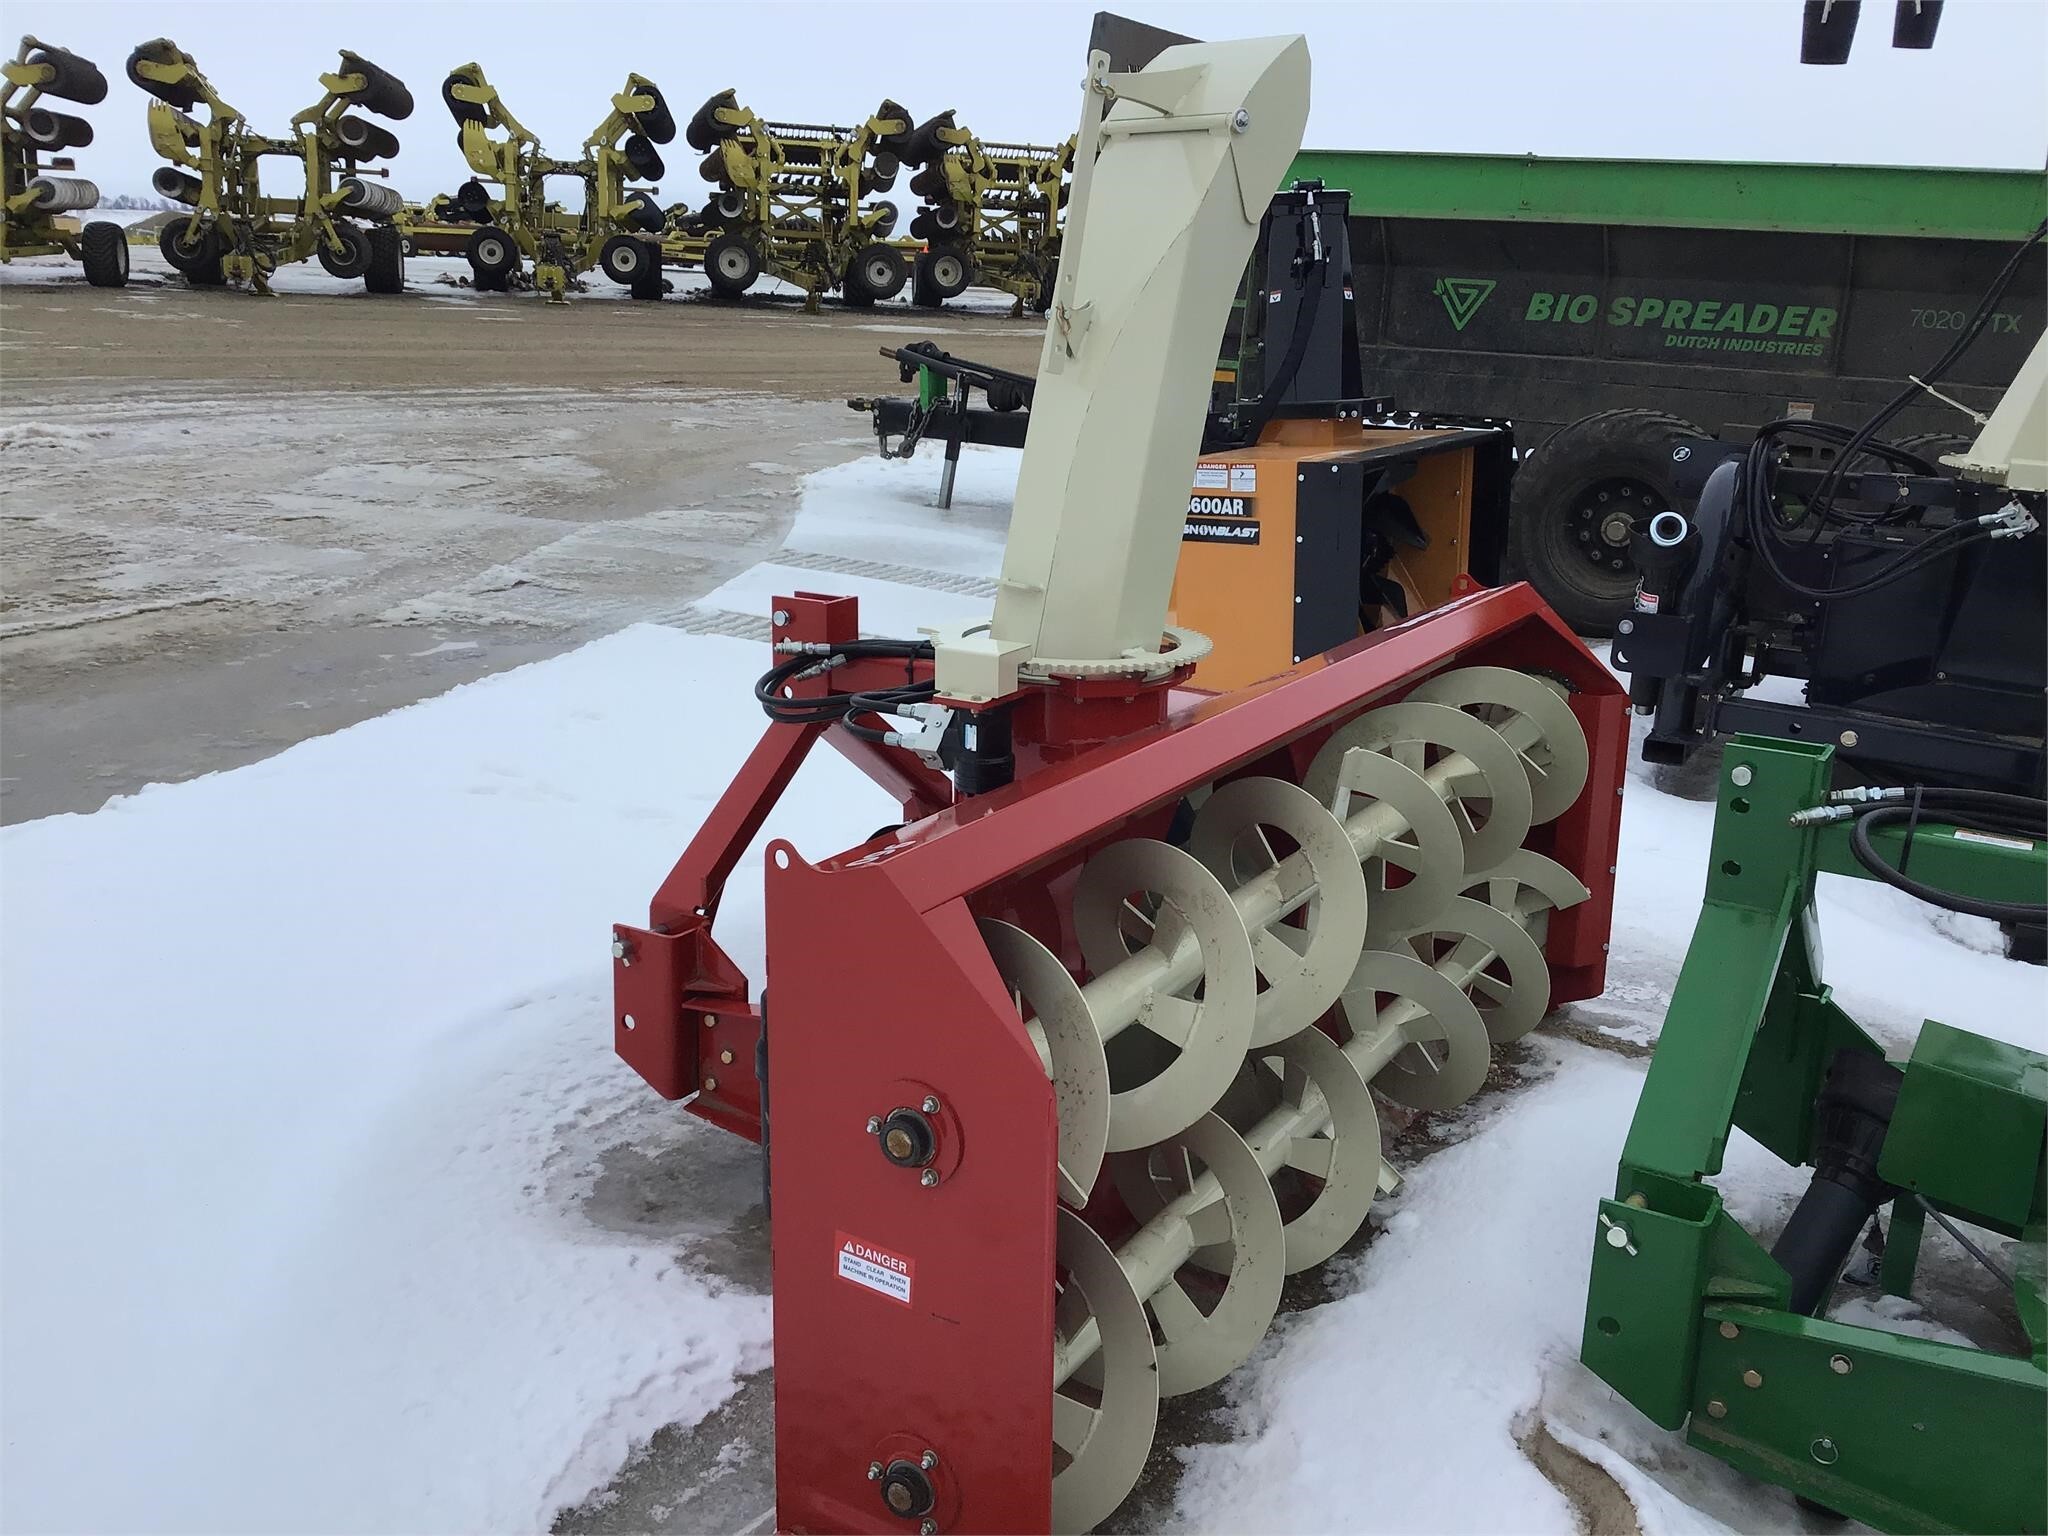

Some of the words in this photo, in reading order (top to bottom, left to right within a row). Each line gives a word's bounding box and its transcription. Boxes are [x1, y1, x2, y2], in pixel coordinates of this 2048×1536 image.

[1525, 292, 1599, 324] BIO
[1607, 296, 1839, 338] SPREADER
[1911, 308, 1966, 331] 7020
[1664, 334, 1721, 350] DUTCH
[1723, 338, 1825, 357] INDUSTRIES
[1187, 497, 1244, 515] 600AR
[843, 1256, 862, 1267] STAND
[866, 1265, 885, 1277] CLEAR
[889, 1273, 907, 1285] WHEN
[855, 1244, 907, 1274] DANGER
[843, 1264, 867, 1279] MACHINE
[868, 1274, 874, 1282] IN
[874, 1277, 906, 1294] OPERATION
